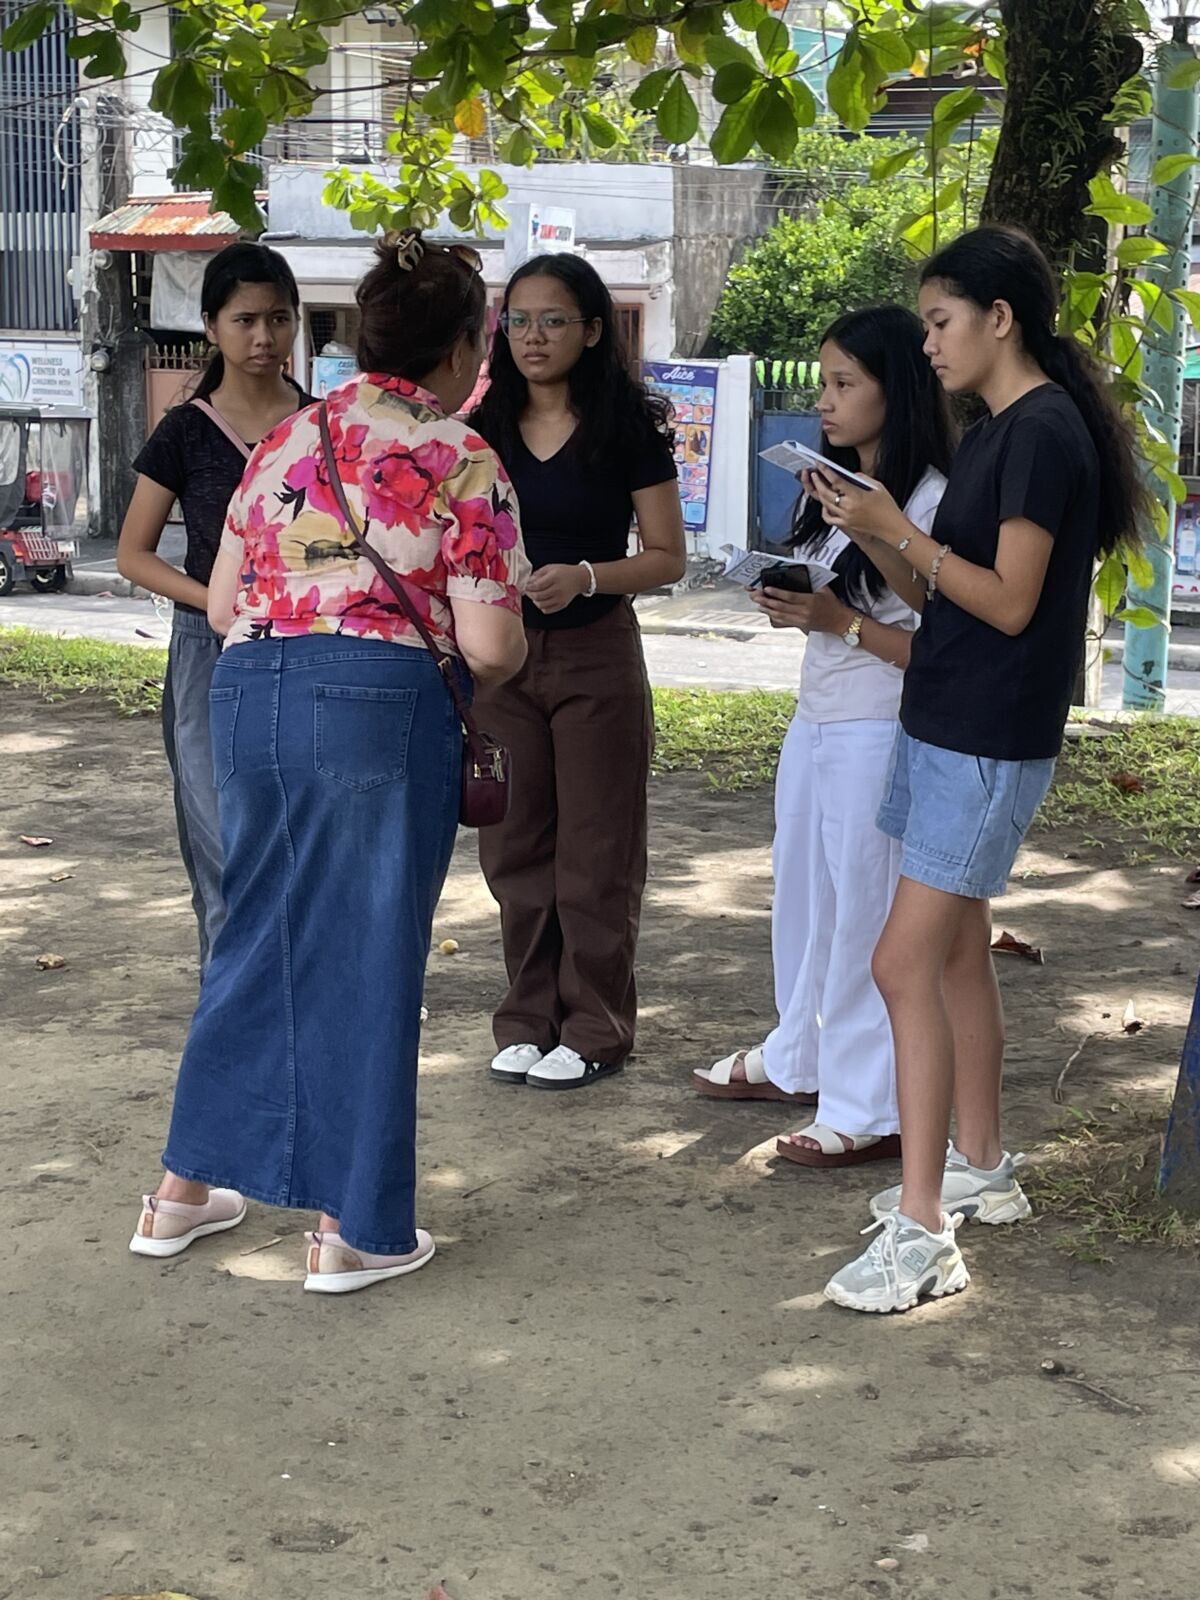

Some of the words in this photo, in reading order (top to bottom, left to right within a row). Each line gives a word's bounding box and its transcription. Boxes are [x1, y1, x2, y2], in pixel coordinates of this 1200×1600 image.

[32, 357, 63, 366] WELLNESS
[32, 367, 56, 376] CENTER
[57, 368, 70, 377] FOR
[662, 366, 695, 381] Aice
